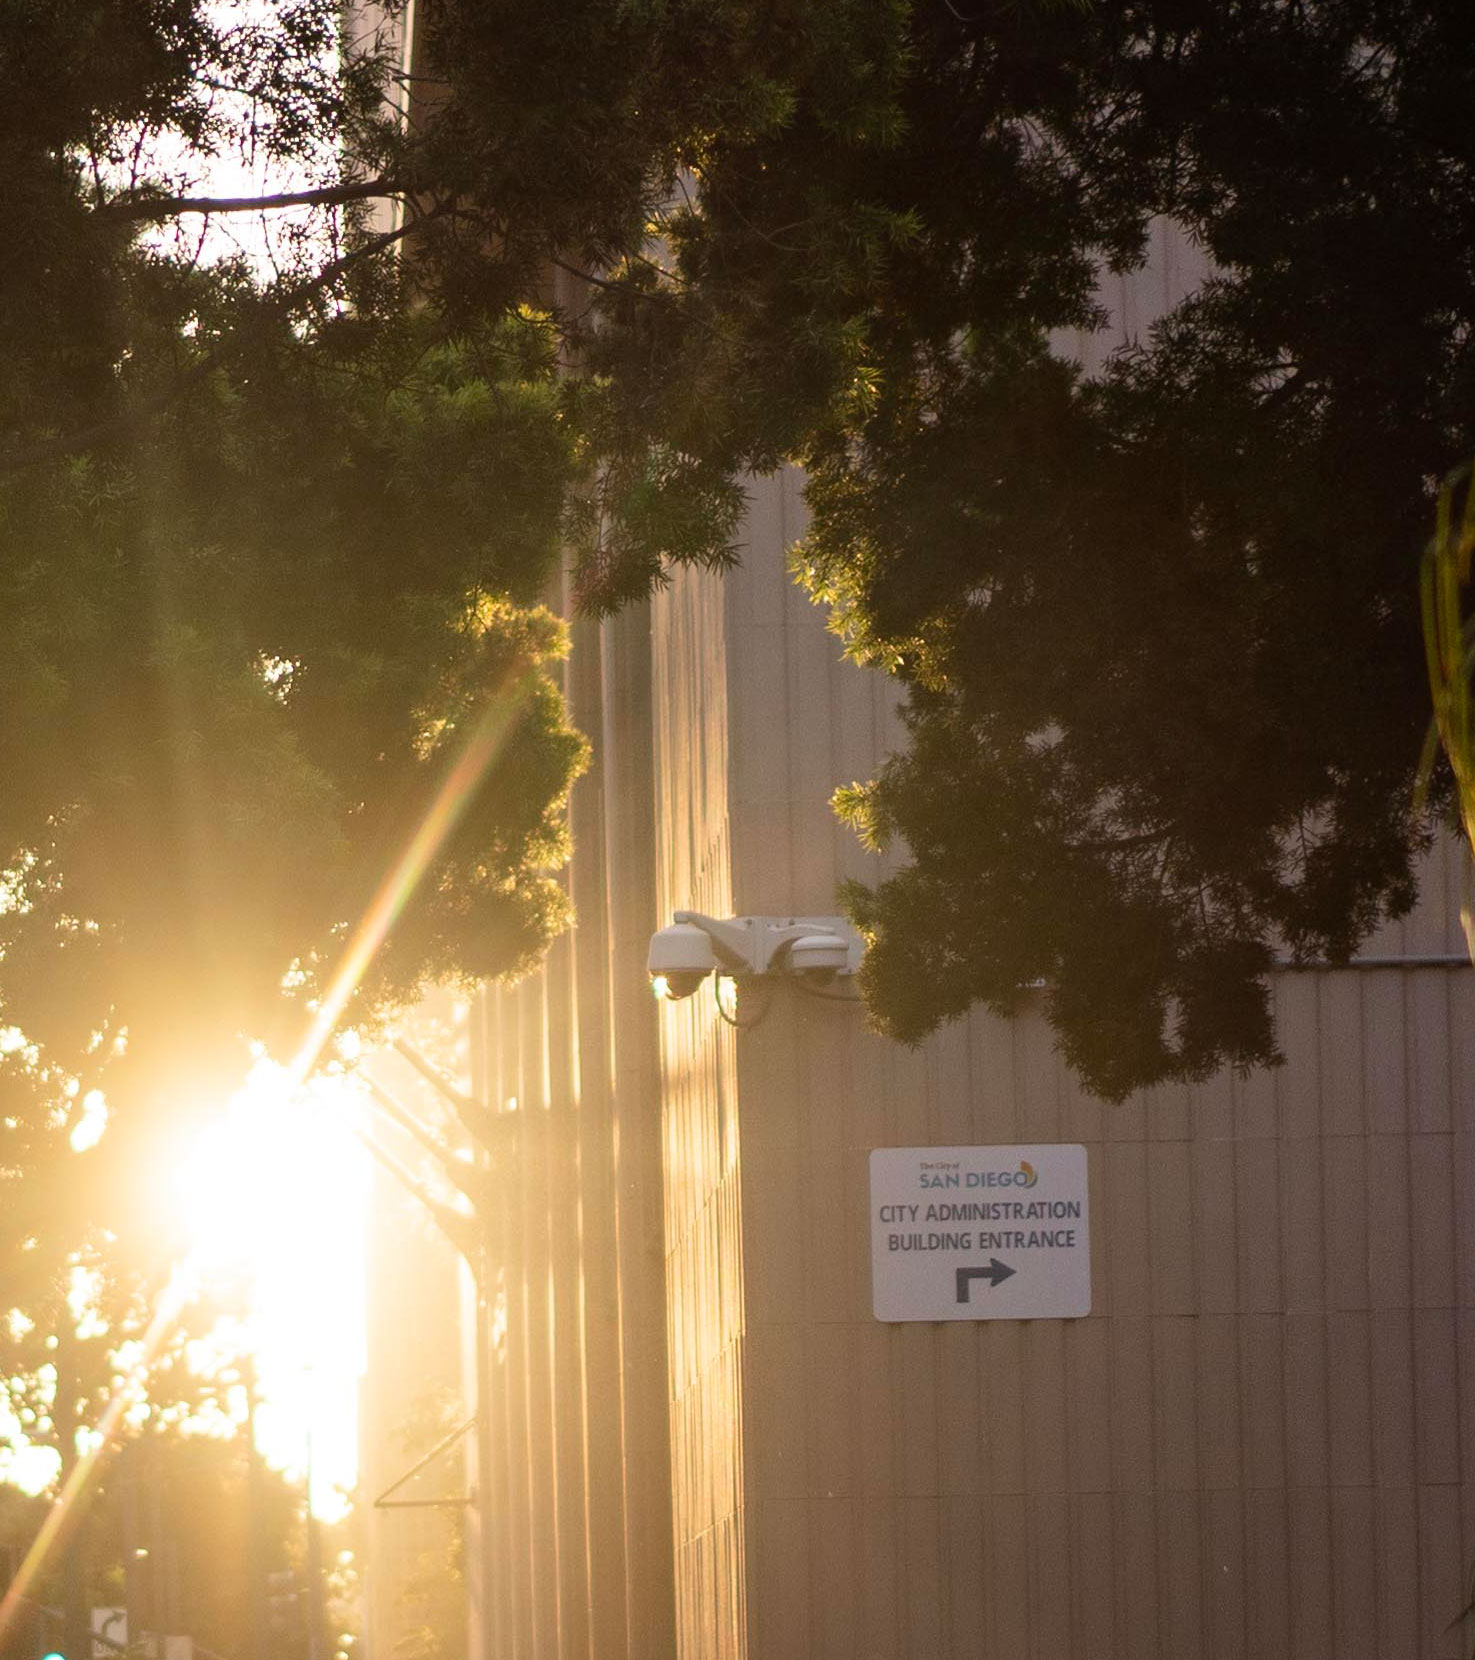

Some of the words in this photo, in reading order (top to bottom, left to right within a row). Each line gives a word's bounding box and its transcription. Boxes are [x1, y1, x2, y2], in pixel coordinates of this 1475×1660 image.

[920, 1174, 959, 1188] SAN
[966, 1172, 1028, 1187] DIEGO
[879, 1205, 919, 1222] CITY
[926, 1201, 1081, 1221] ADMINISTRATION
[889, 1232, 971, 1251] BUILDING
[980, 1230, 1076, 1248] ENTRANCE
